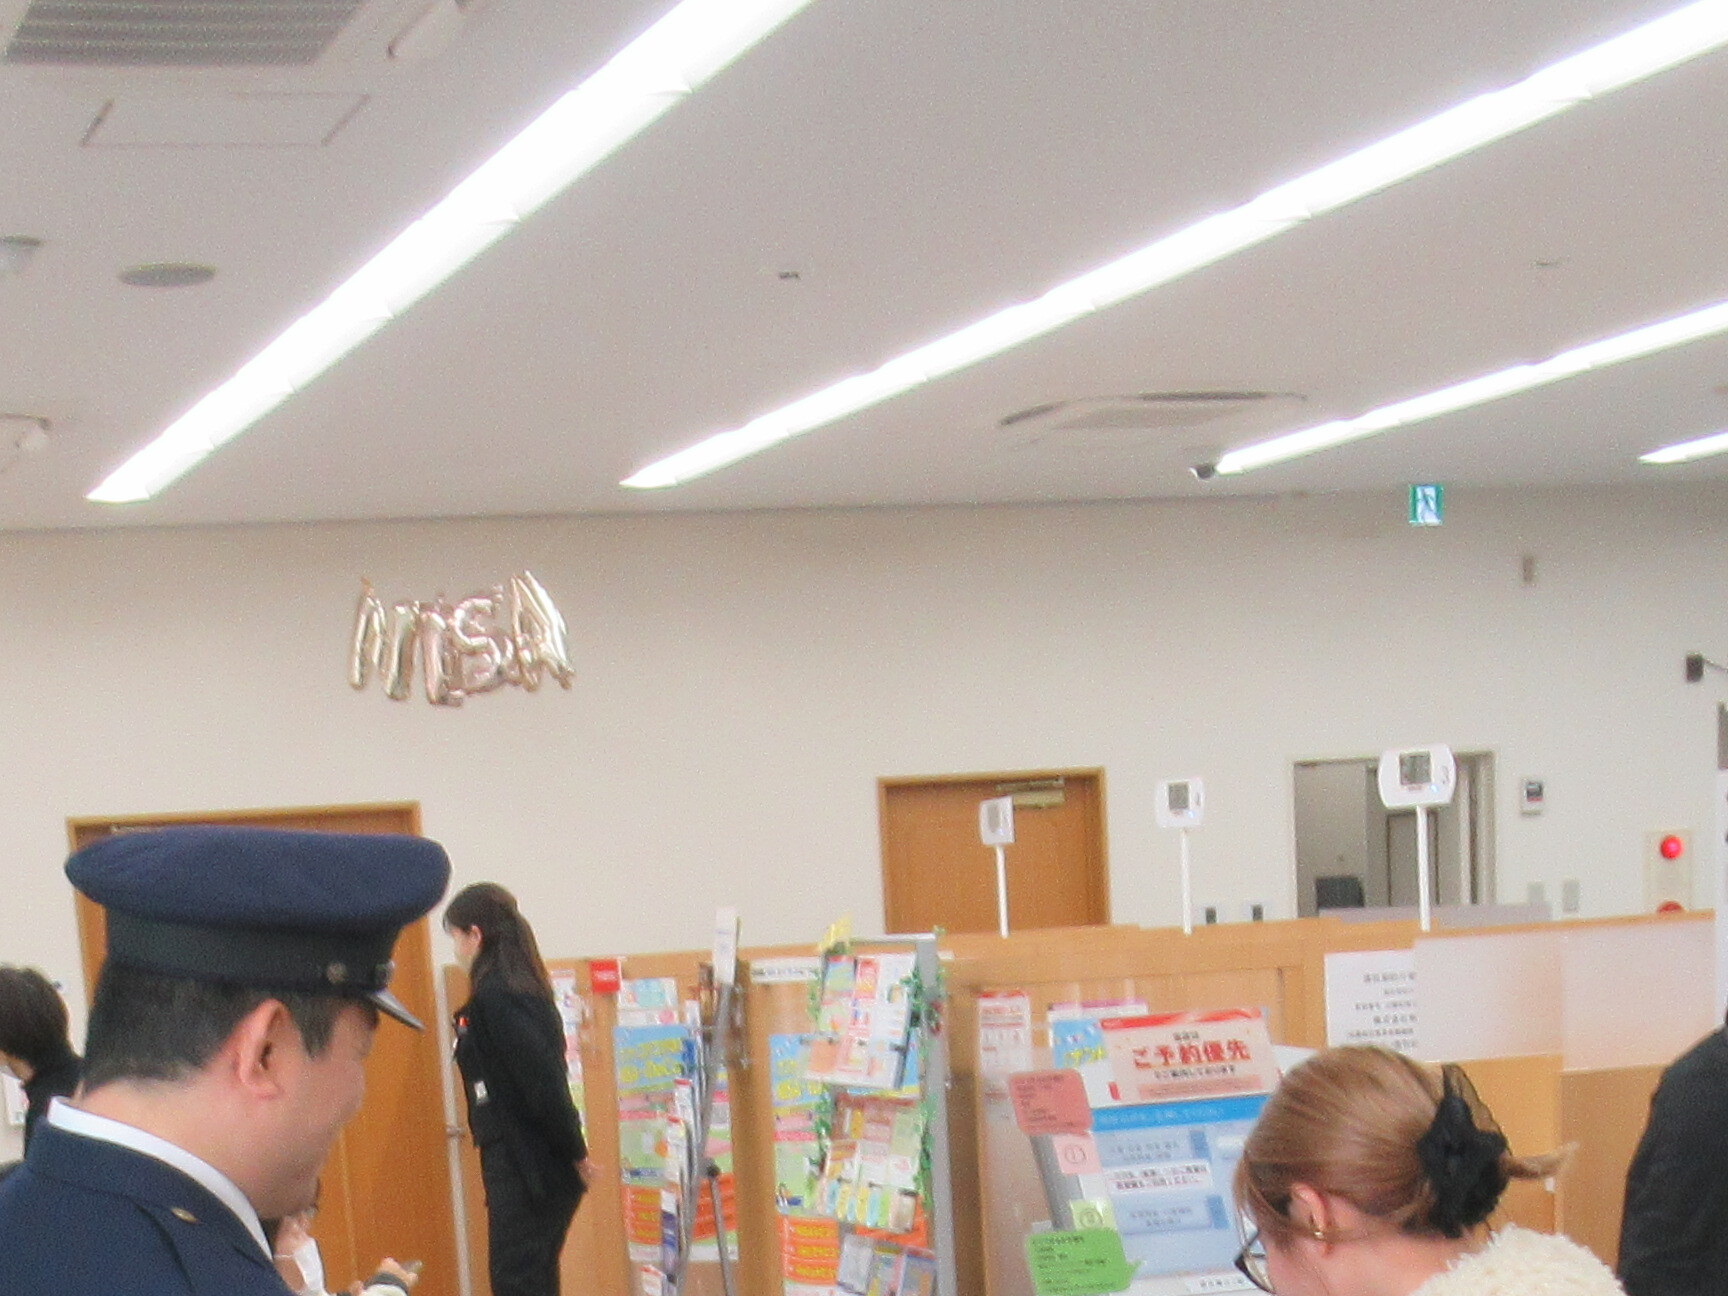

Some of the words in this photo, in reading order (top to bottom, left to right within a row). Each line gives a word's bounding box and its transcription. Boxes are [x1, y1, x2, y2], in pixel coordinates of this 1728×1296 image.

[1132, 1039, 1252, 1069] ご予約優先
